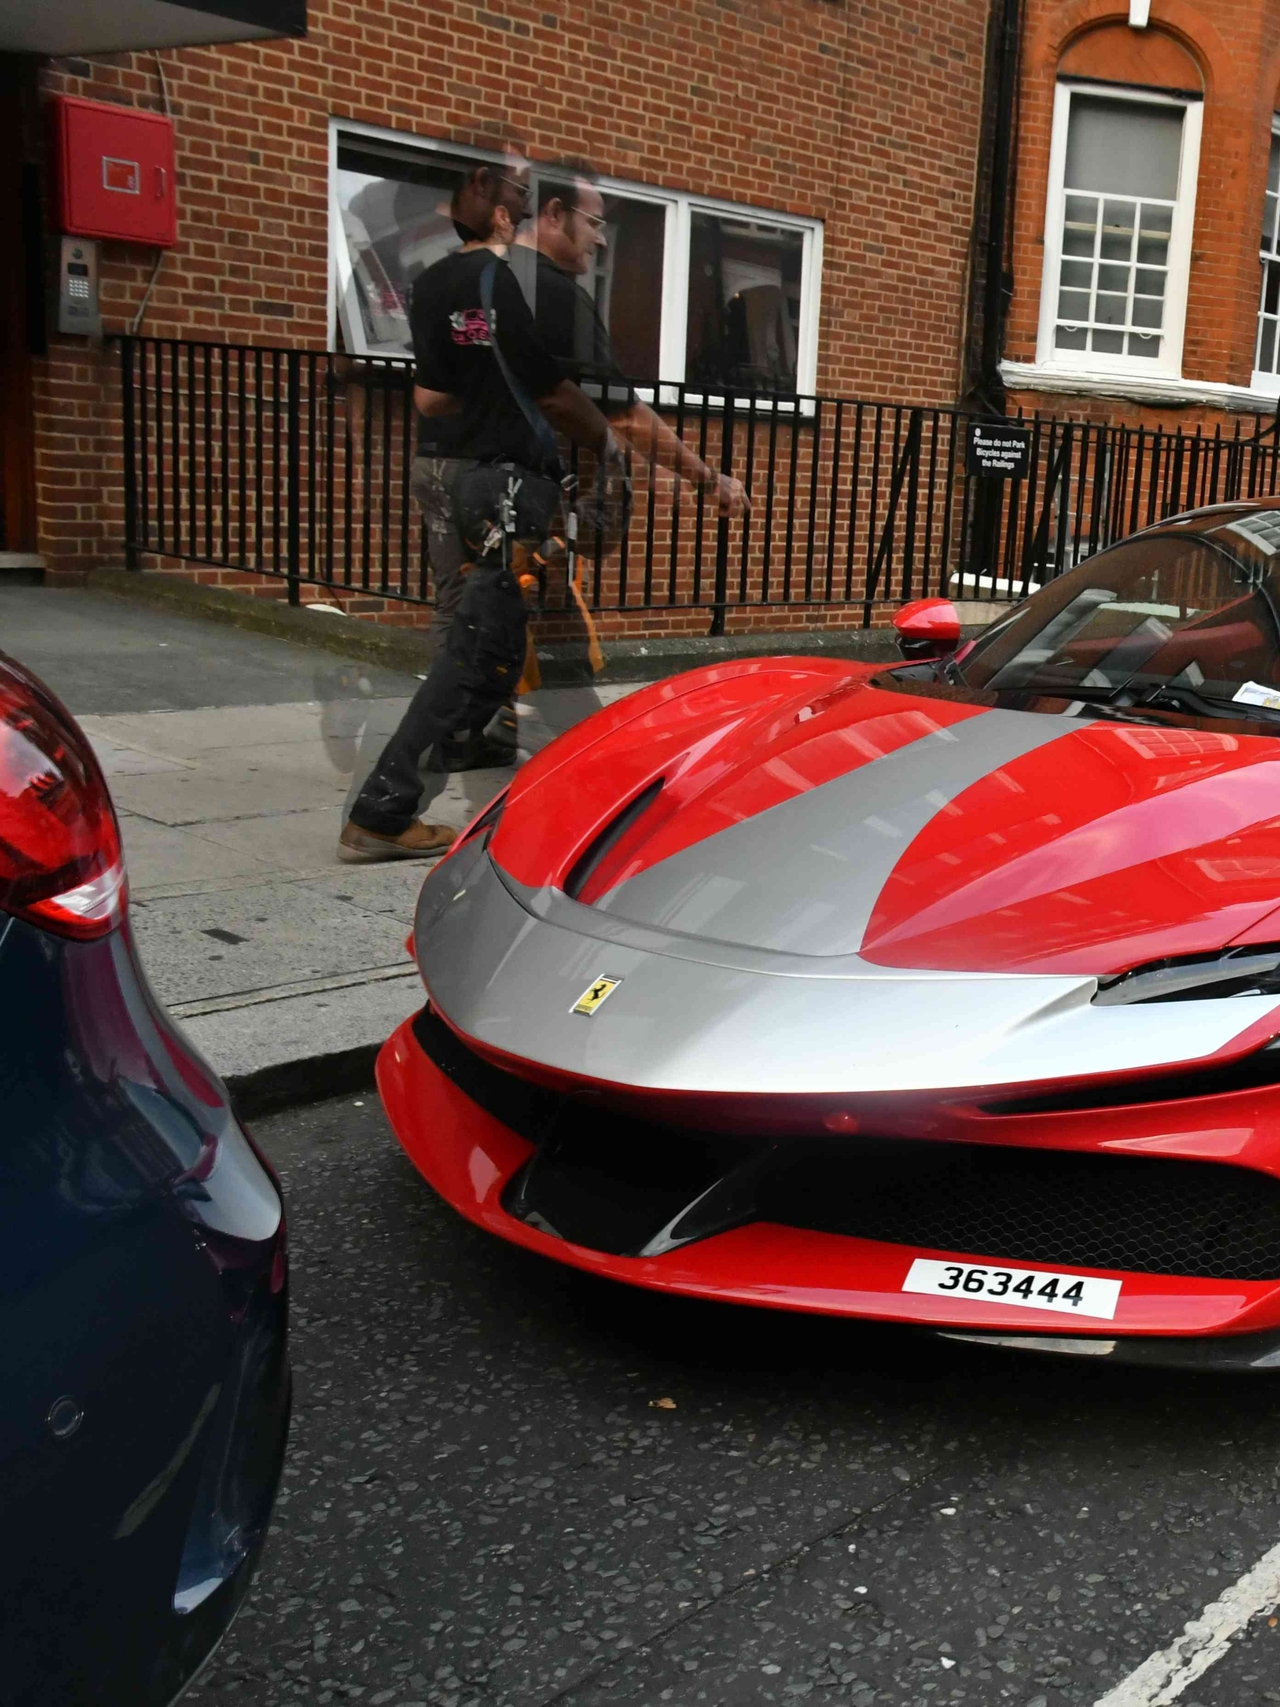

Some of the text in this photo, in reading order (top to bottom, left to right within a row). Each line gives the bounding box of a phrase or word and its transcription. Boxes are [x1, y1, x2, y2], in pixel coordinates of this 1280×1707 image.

[973, 437, 992, 446] Please
[1002, 440, 1011, 448] not
[1012, 440, 1025, 449] Park
[976, 447, 1021, 460] Bicycles against
[982, 459, 1015, 470] the Railings
[938, 1266, 1085, 1307] 363444
